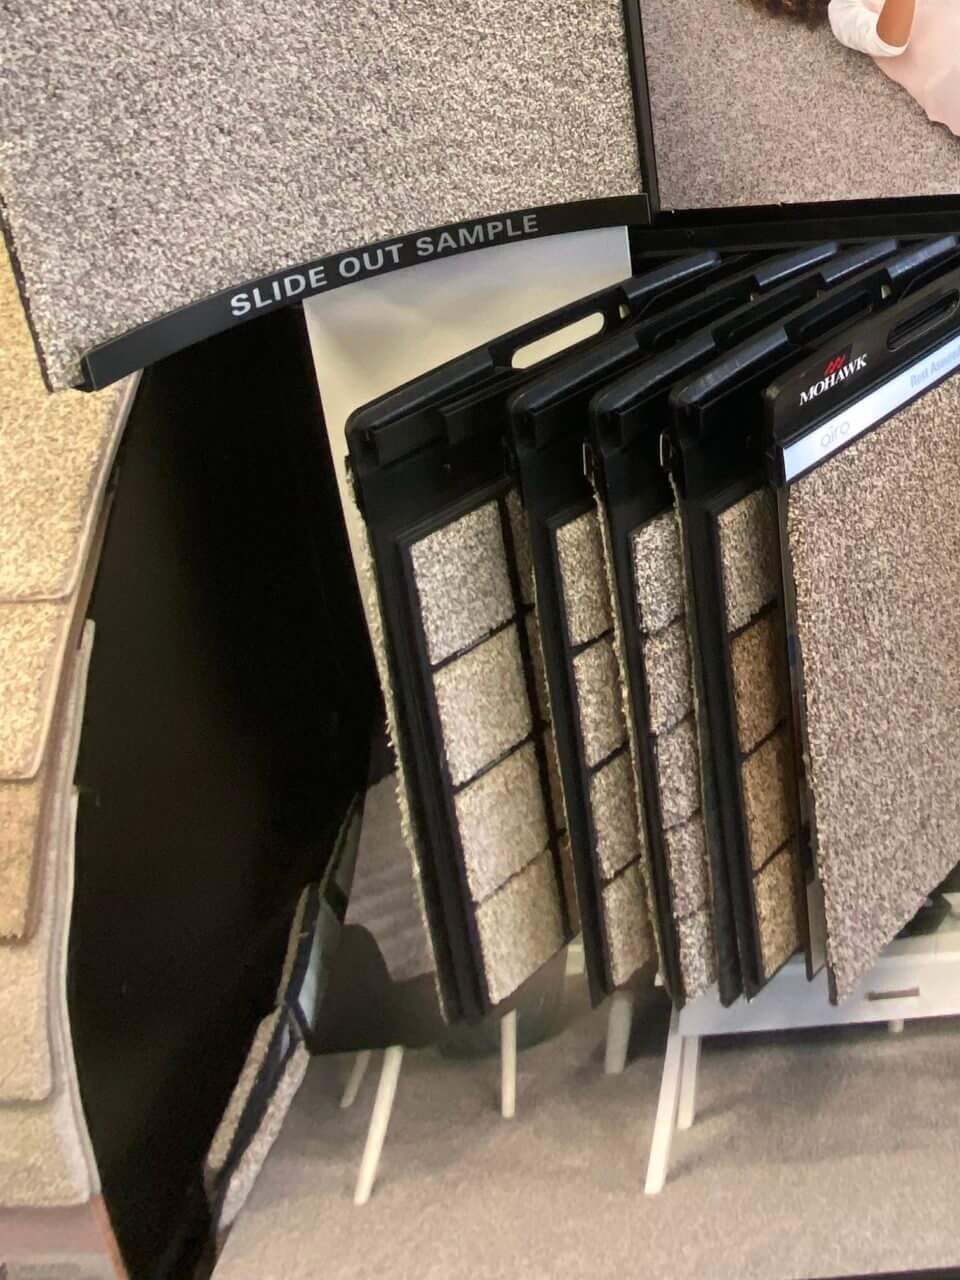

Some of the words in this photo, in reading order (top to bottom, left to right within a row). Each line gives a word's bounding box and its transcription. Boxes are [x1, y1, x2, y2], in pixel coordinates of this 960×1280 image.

[230, 266, 328, 317] SLIDE
[338, 243, 404, 279] OUT
[416, 214, 539, 258] SAMPLE
[799, 353, 868, 407] MOHAWK
